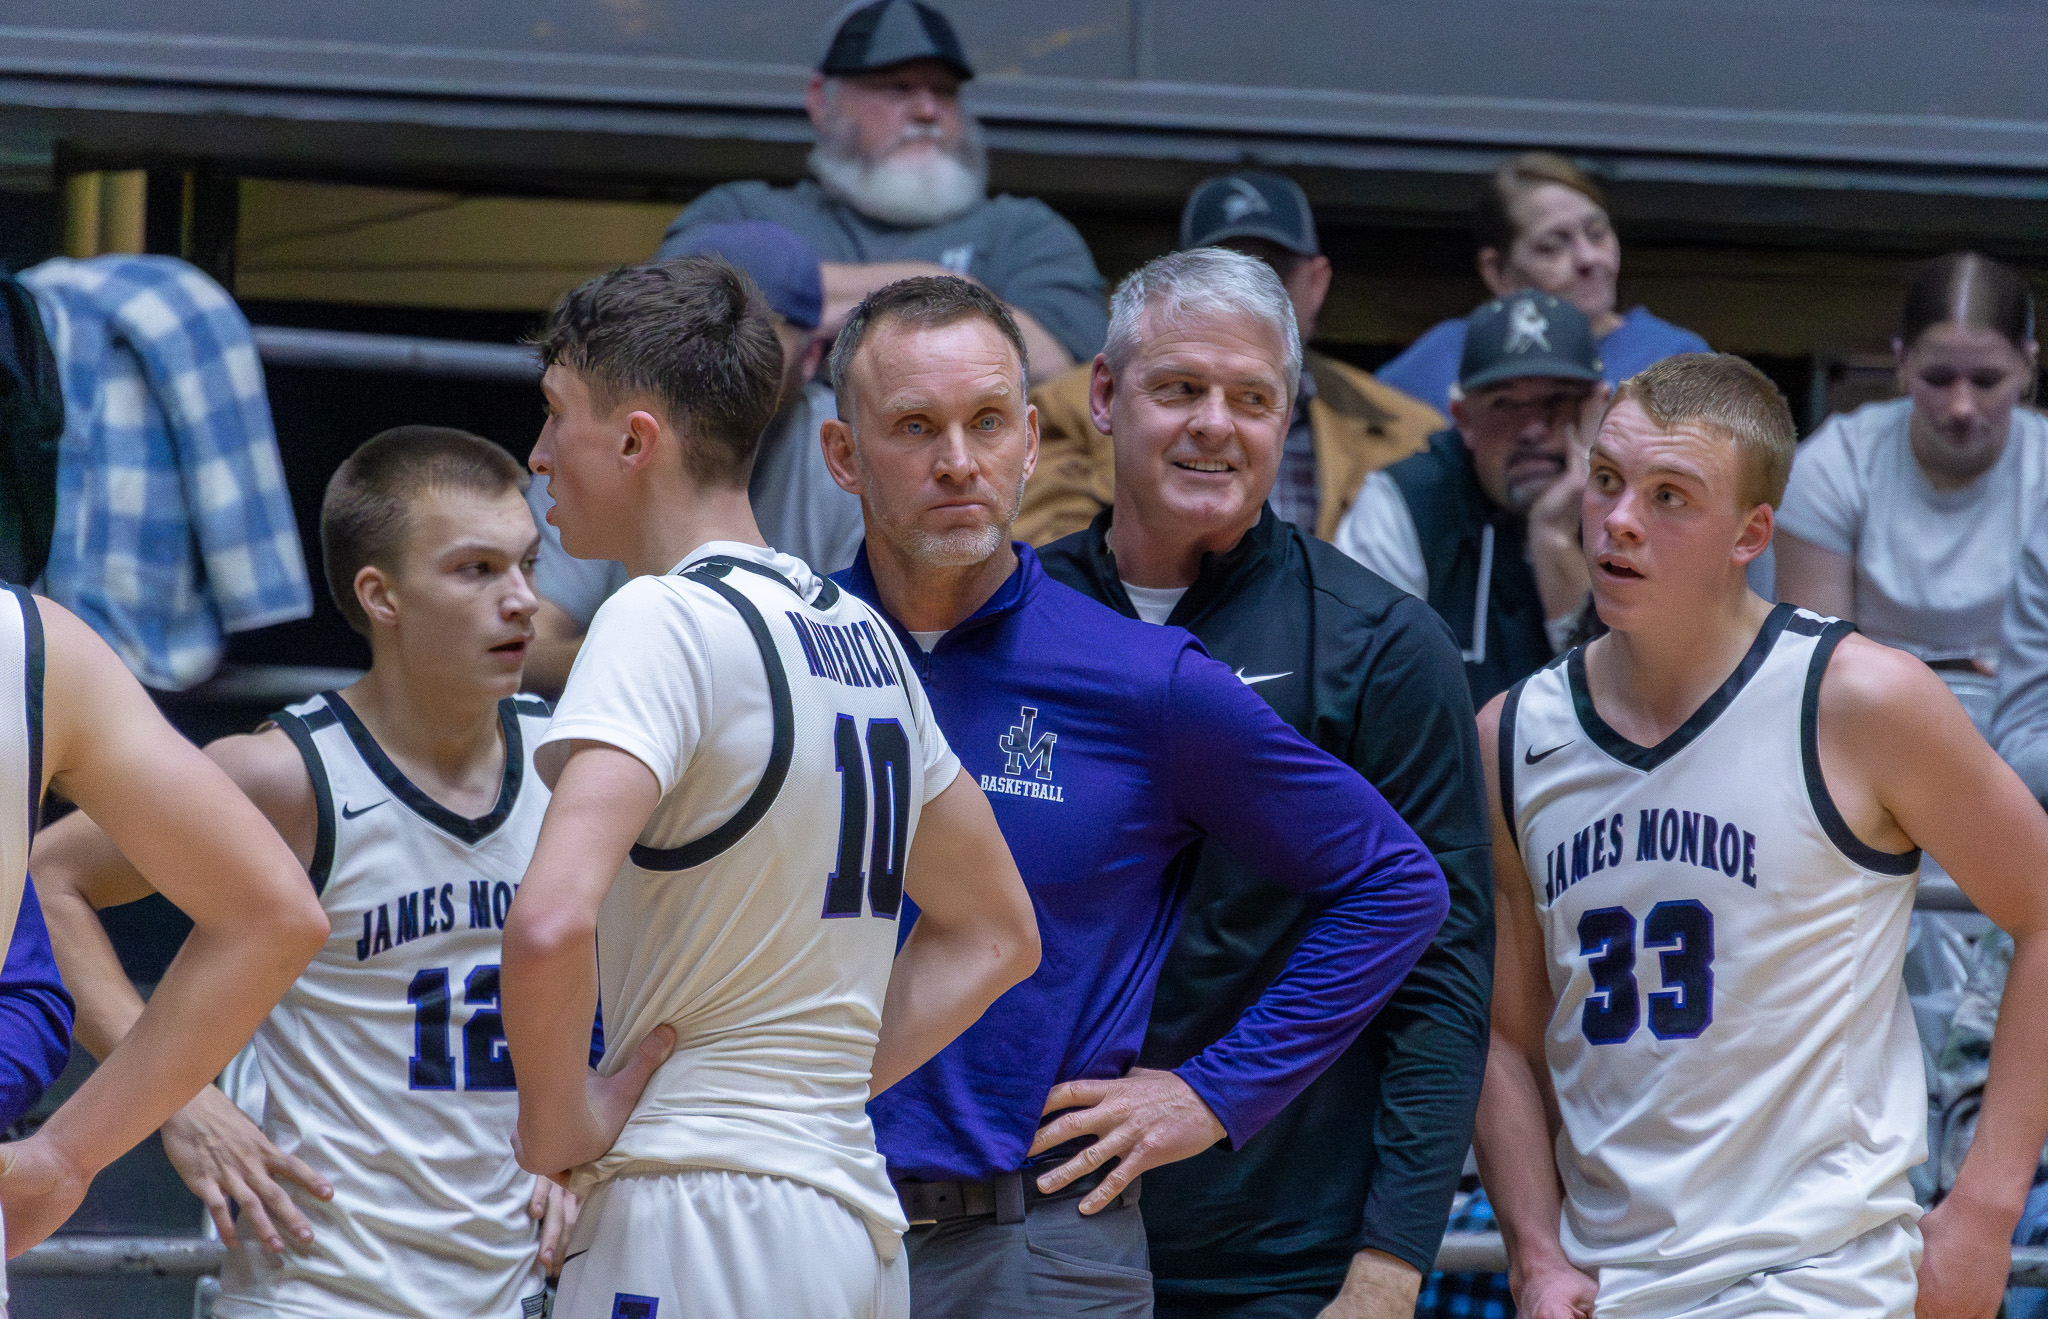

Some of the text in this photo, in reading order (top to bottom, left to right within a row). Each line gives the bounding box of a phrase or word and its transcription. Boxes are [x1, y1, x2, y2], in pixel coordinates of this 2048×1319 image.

[821, 712, 911, 921] 10
[981, 775, 1064, 803] BASKETBALL
[1545, 808, 1757, 908] JAMES MONROE
[356, 880, 520, 962] JAMES MO
[1577, 899, 1715, 1046] 33
[407, 964, 518, 1092] 12
